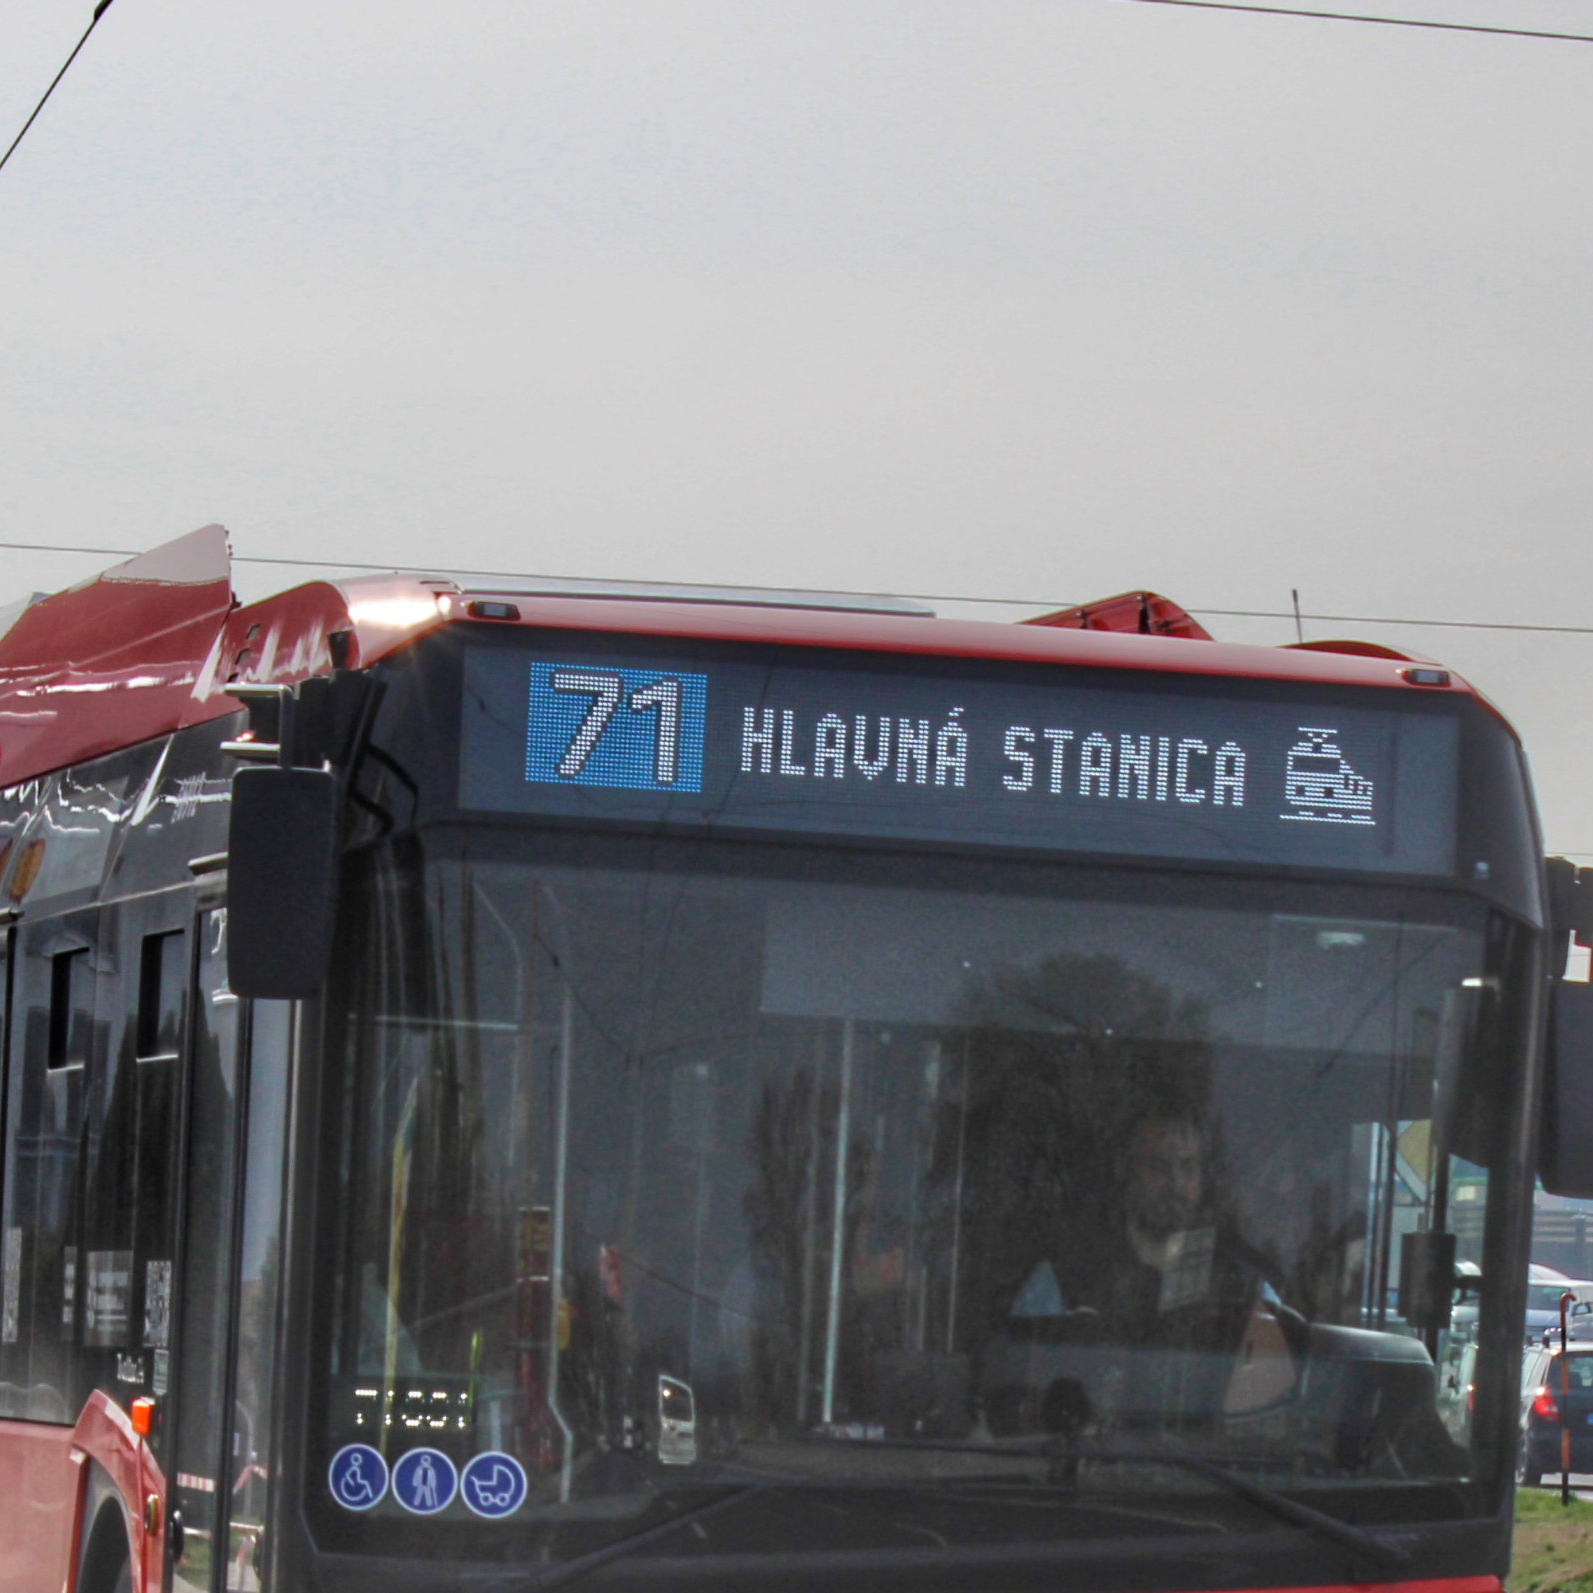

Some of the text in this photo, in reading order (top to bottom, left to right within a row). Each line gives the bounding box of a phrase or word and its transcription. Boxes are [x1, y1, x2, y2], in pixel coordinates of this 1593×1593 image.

[553, 672, 1246, 807] 71 HLAVNÁ STANICA
